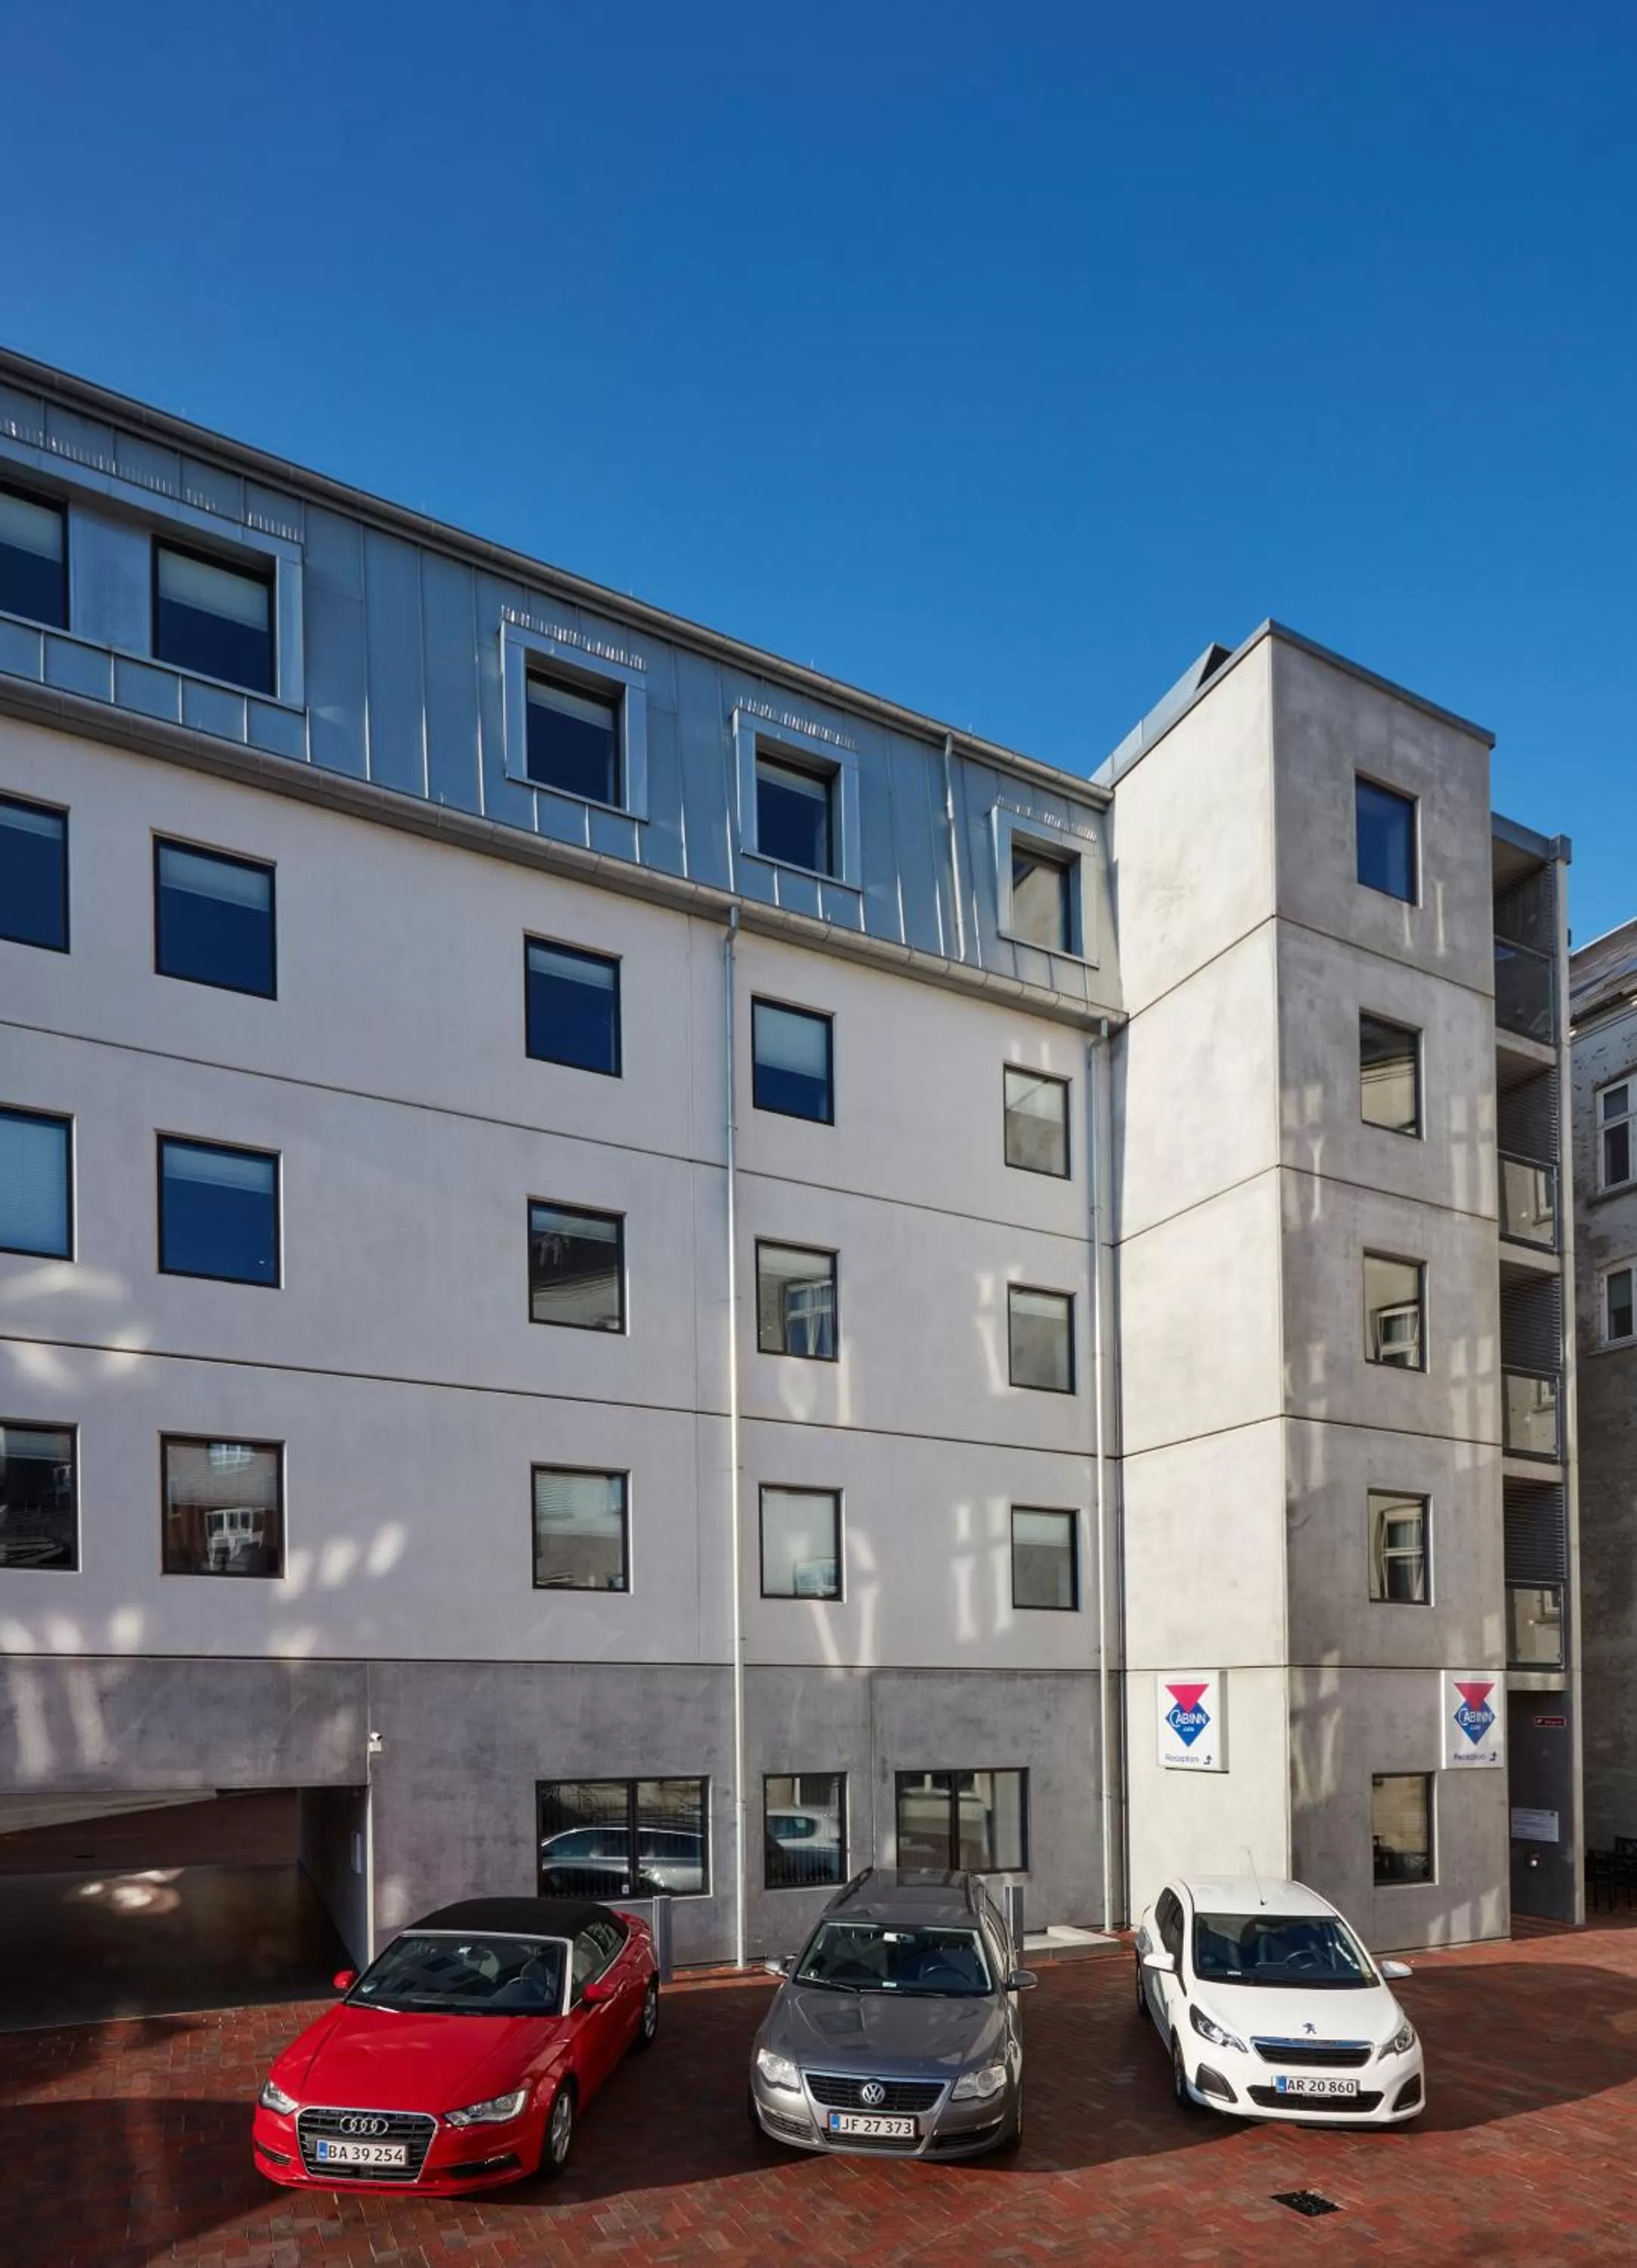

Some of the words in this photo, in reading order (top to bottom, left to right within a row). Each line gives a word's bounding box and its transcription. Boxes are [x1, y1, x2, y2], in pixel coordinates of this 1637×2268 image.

[1169, 1709, 1206, 1727] CABINN
[1458, 1708, 1493, 1725] CABINN
[1165, 1753, 1199, 1763] Reception
[1287, 2080, 1305, 2091] AR
[1309, 2080, 1325, 2092] 20
[1329, 2081, 1354, 2093] 860
[842, 2118, 859, 2131] JF
[864, 2120, 881, 2133] 27
[885, 2121, 912, 2134] 373
[329, 2145, 348, 2159] BA
[351, 2146, 370, 2161] 39
[374, 2148, 403, 2162] 254
